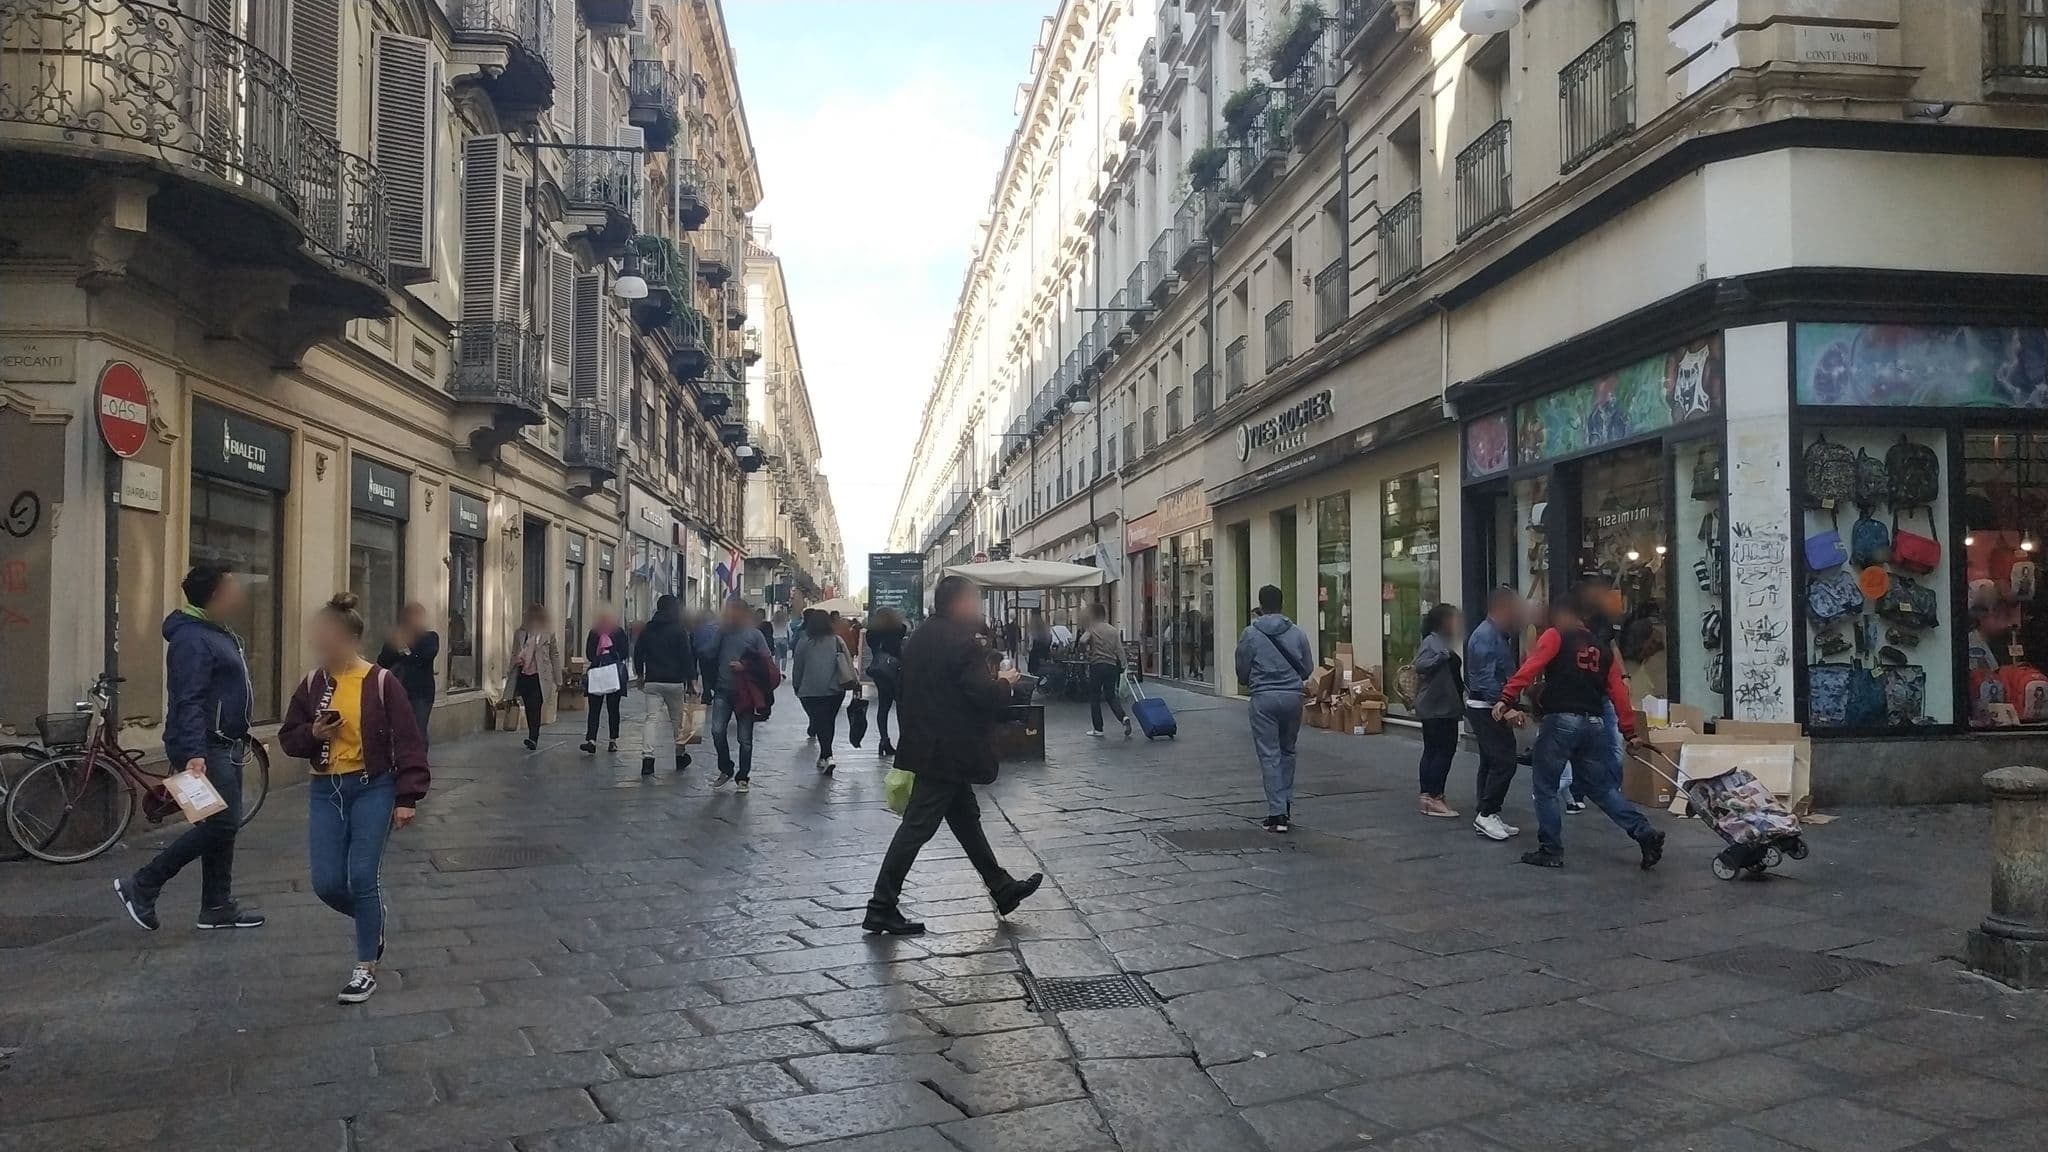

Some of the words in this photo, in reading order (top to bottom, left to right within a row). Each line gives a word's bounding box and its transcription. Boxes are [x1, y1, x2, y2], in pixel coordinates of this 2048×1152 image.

[1829, 32, 1846, 42] VIA
[1806, 51, 1837, 61] CONTE
[24, 343, 38, 351] VIA
[1249, 417, 1278, 449] YVES
[1279, 390, 1334, 436] ROCHER
[230, 439, 266, 464] BIALETTI
[1576, 646, 1601, 673] 23
